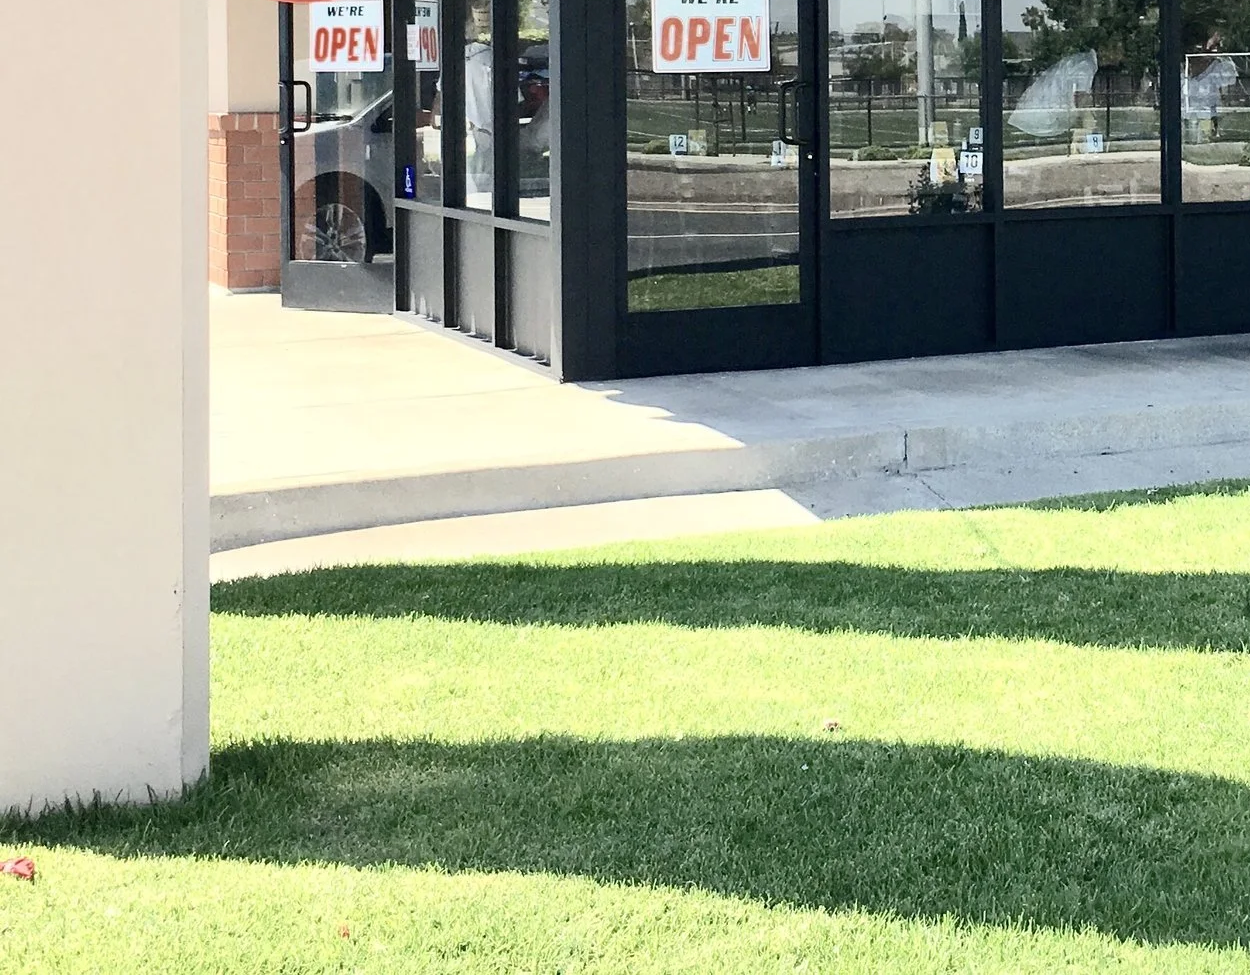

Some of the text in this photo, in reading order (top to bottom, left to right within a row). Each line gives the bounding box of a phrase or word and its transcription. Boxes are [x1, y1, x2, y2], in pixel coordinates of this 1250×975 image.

[327, 6, 364, 17] WE'RE
[314, 26, 379, 63] OPEN
[660, 16, 763, 62] OPEN
[673, 136, 684, 148] 12
[964, 154, 978, 168] 10
